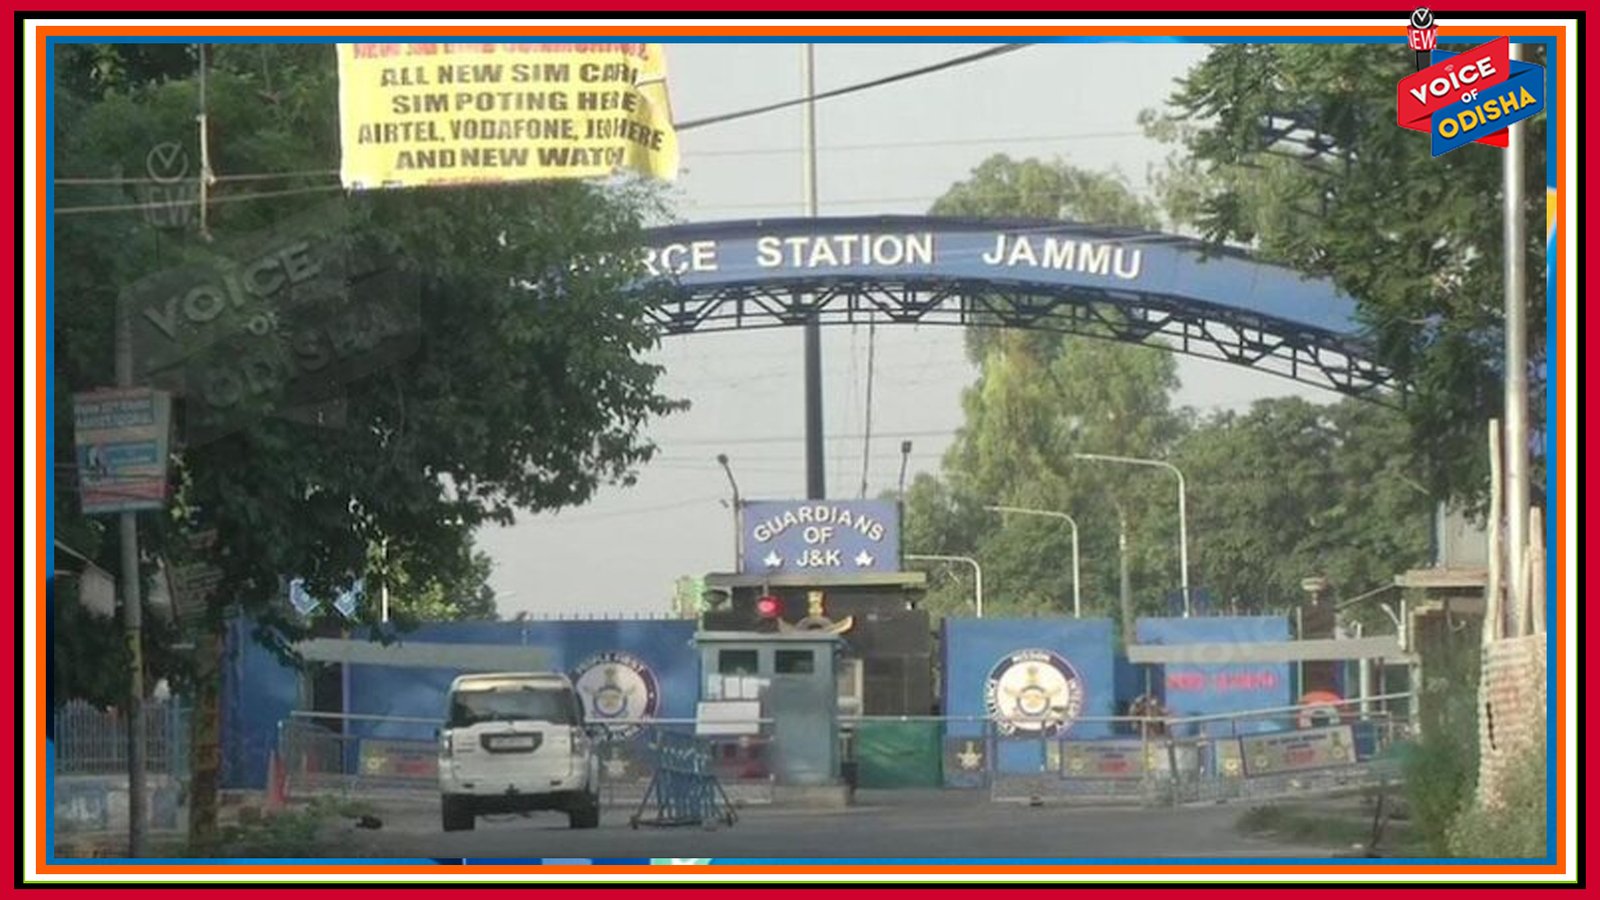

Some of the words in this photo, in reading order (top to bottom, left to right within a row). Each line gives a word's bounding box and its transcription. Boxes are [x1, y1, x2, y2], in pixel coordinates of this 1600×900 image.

[380, 66, 430, 87] ALL
[438, 64, 503, 85] NEW
[511, 63, 570, 83] SIM
[392, 93, 448, 115] SIM
[455, 92, 568, 112] POTING
[395, 148, 455, 169] AND
[460, 148, 528, 168] NEW
[756, 233, 933, 269] STATION
[982, 234, 1142, 279] JAMMU
[753, 504, 885, 543] GUARDIANS
[803, 526, 834, 545] OF
[796, 550, 841, 567] J&K
